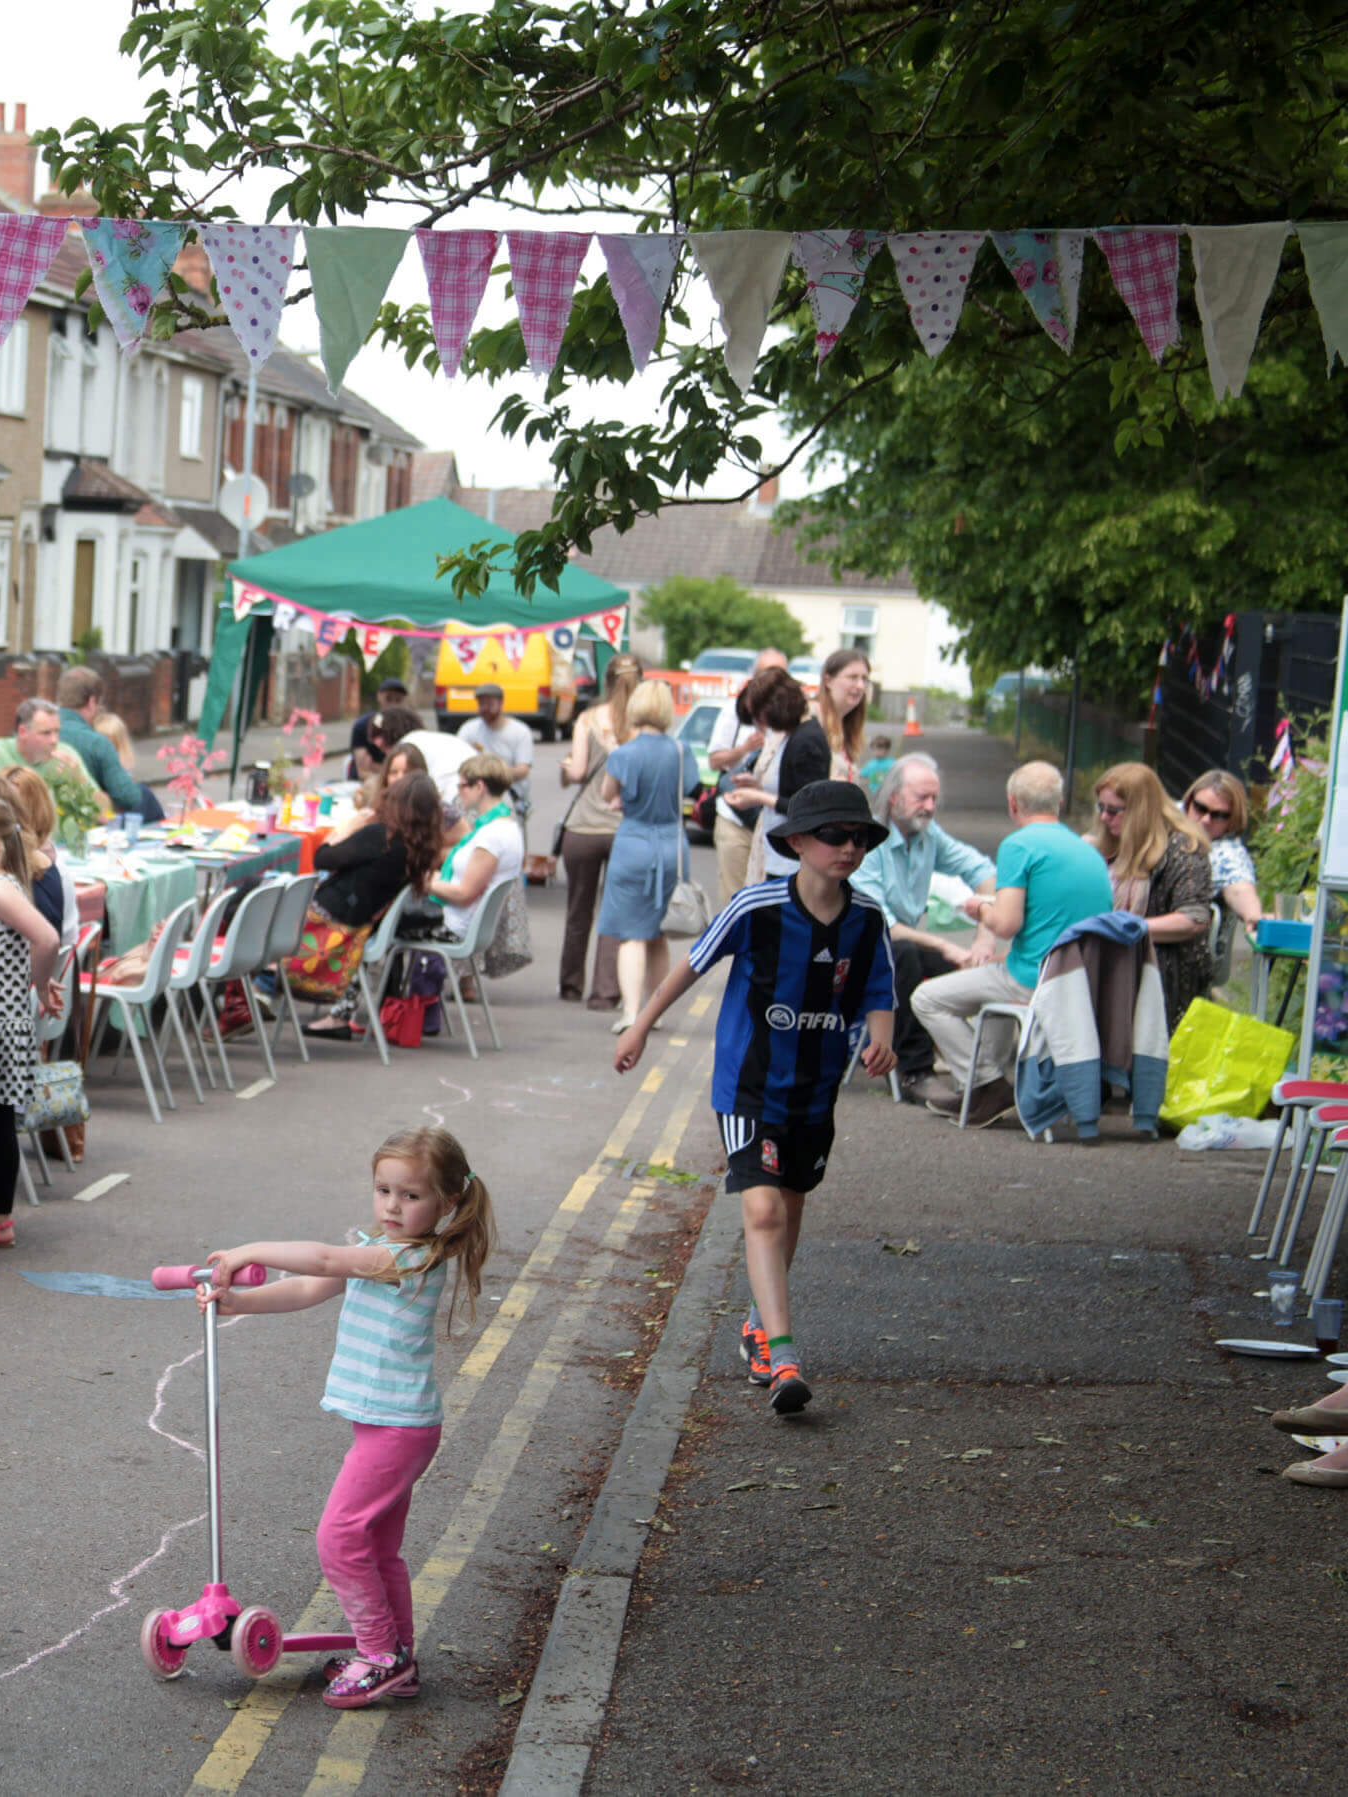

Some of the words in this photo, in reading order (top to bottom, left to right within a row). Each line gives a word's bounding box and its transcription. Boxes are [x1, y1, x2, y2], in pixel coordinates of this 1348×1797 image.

[238, 588, 381, 656] FREE
[456, 614, 621, 663] SHOP
[797, 1012, 838, 1031] FIFA
